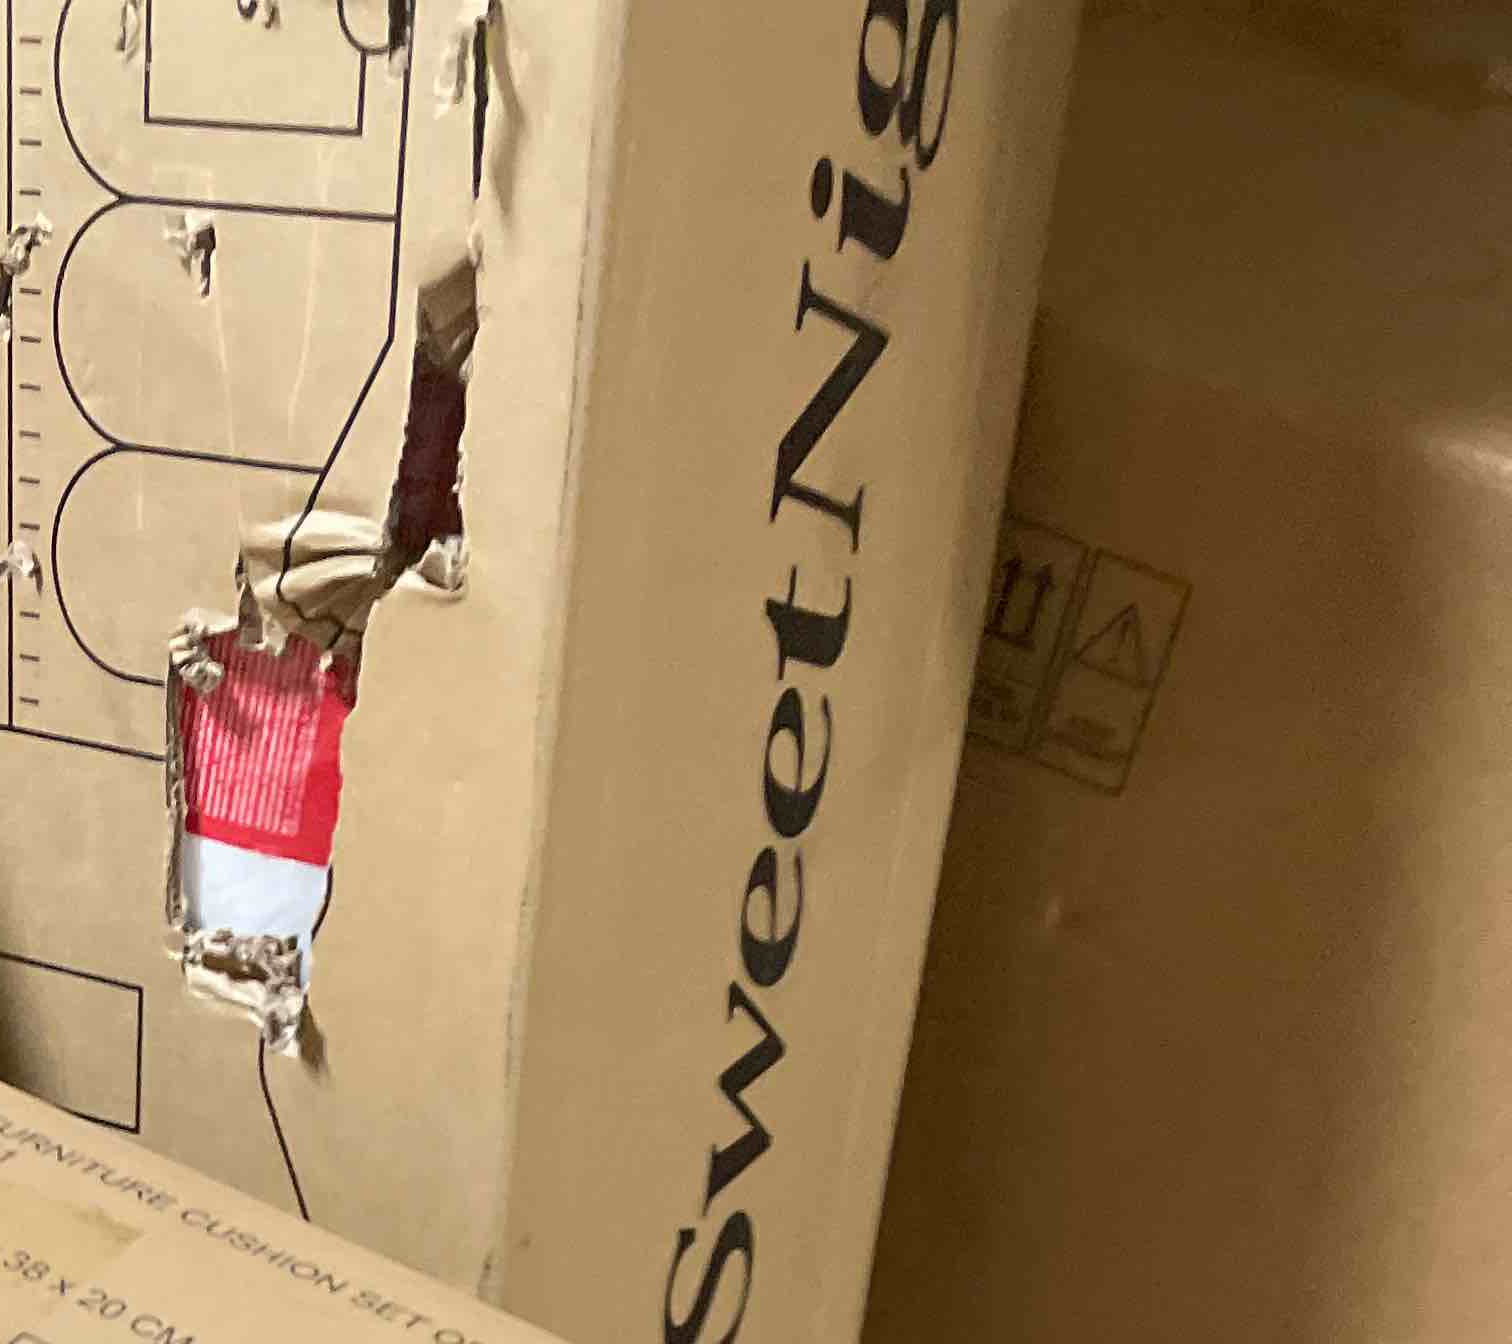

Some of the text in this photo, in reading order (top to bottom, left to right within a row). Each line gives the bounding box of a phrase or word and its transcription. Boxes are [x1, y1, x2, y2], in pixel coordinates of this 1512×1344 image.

[3, 1249, 51, 1282] 38
[76, 1287, 128, 1321] 20
[180, 1207, 349, 1293] CUSHION
[350, 1288, 432, 1330] SET
